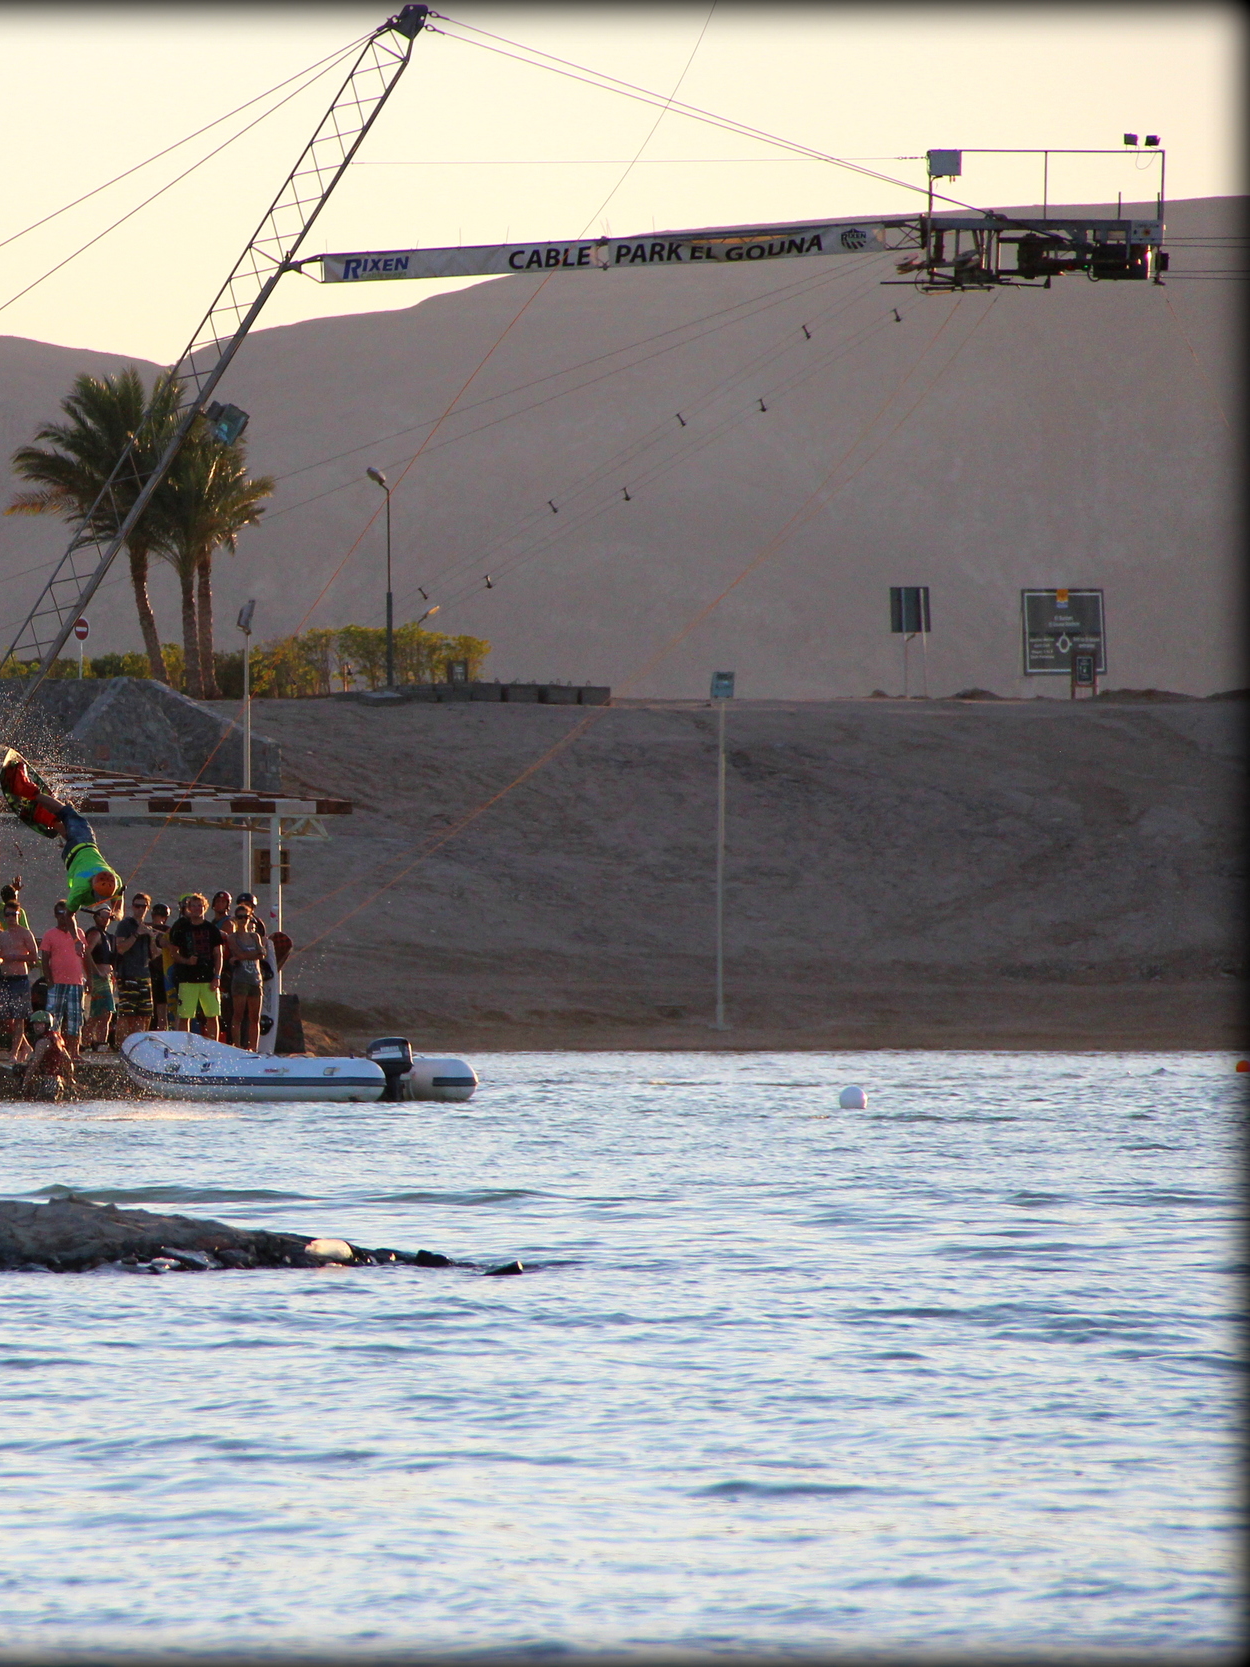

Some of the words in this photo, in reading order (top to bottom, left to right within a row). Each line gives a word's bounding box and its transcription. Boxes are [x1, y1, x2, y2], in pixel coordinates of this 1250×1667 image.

[841, 232, 867, 241] RIXEN
[508, 247, 590, 269] CABLE
[615, 242, 682, 264] PARK
[690, 245, 716, 260] EL
[725, 234, 823, 261] GOUNA
[343, 256, 409, 279] RIXEN
